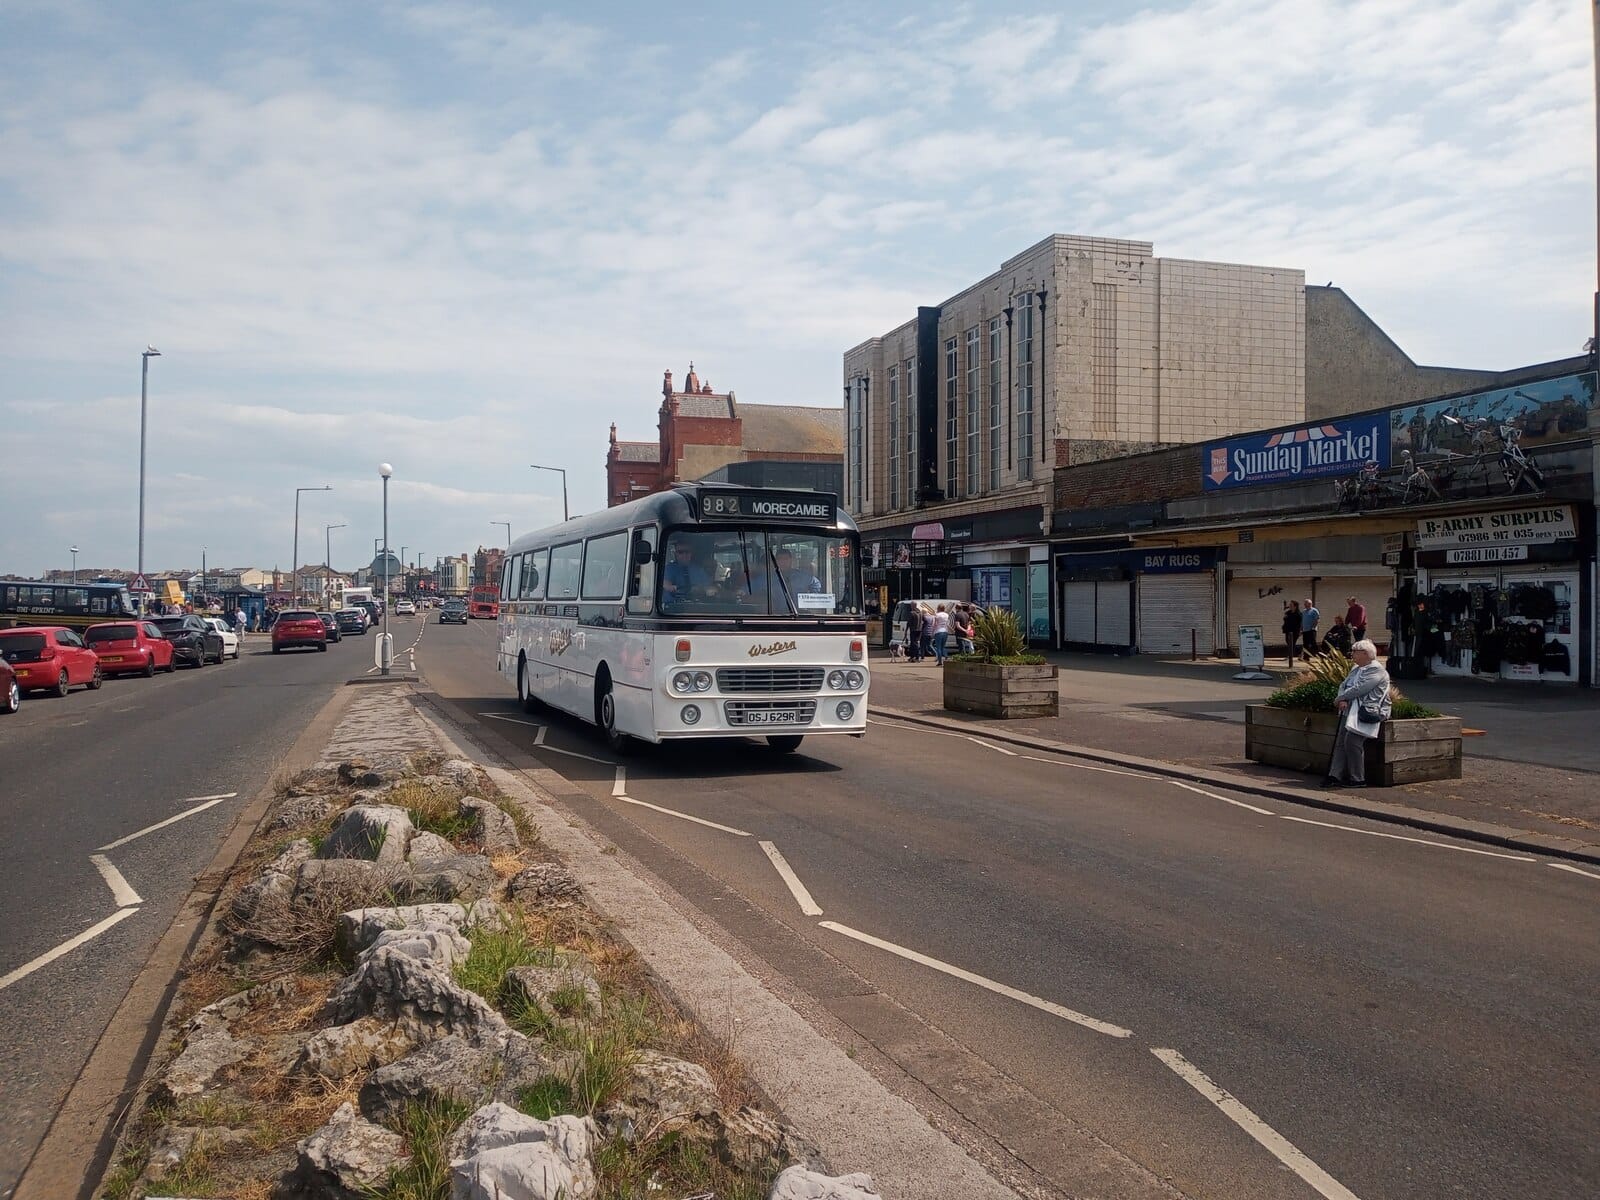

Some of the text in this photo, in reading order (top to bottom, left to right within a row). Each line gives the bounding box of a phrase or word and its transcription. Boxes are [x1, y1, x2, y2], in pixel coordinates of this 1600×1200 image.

[1234, 425, 1379, 481] Sunday Market
[703, 498, 830, 516] 982 MORECAMBE
[1426, 509, 1565, 533] B-ARMY SURPLUS
[1458, 529, 1534, 543] 07986 917 035
[1144, 554, 1200, 567] BAY RUGS
[1453, 549, 1481, 561] 07881
[1501, 548, 1520, 559] 457
[748, 640, 797, 657] Western
[748, 712, 795, 721] OSJ 629R
